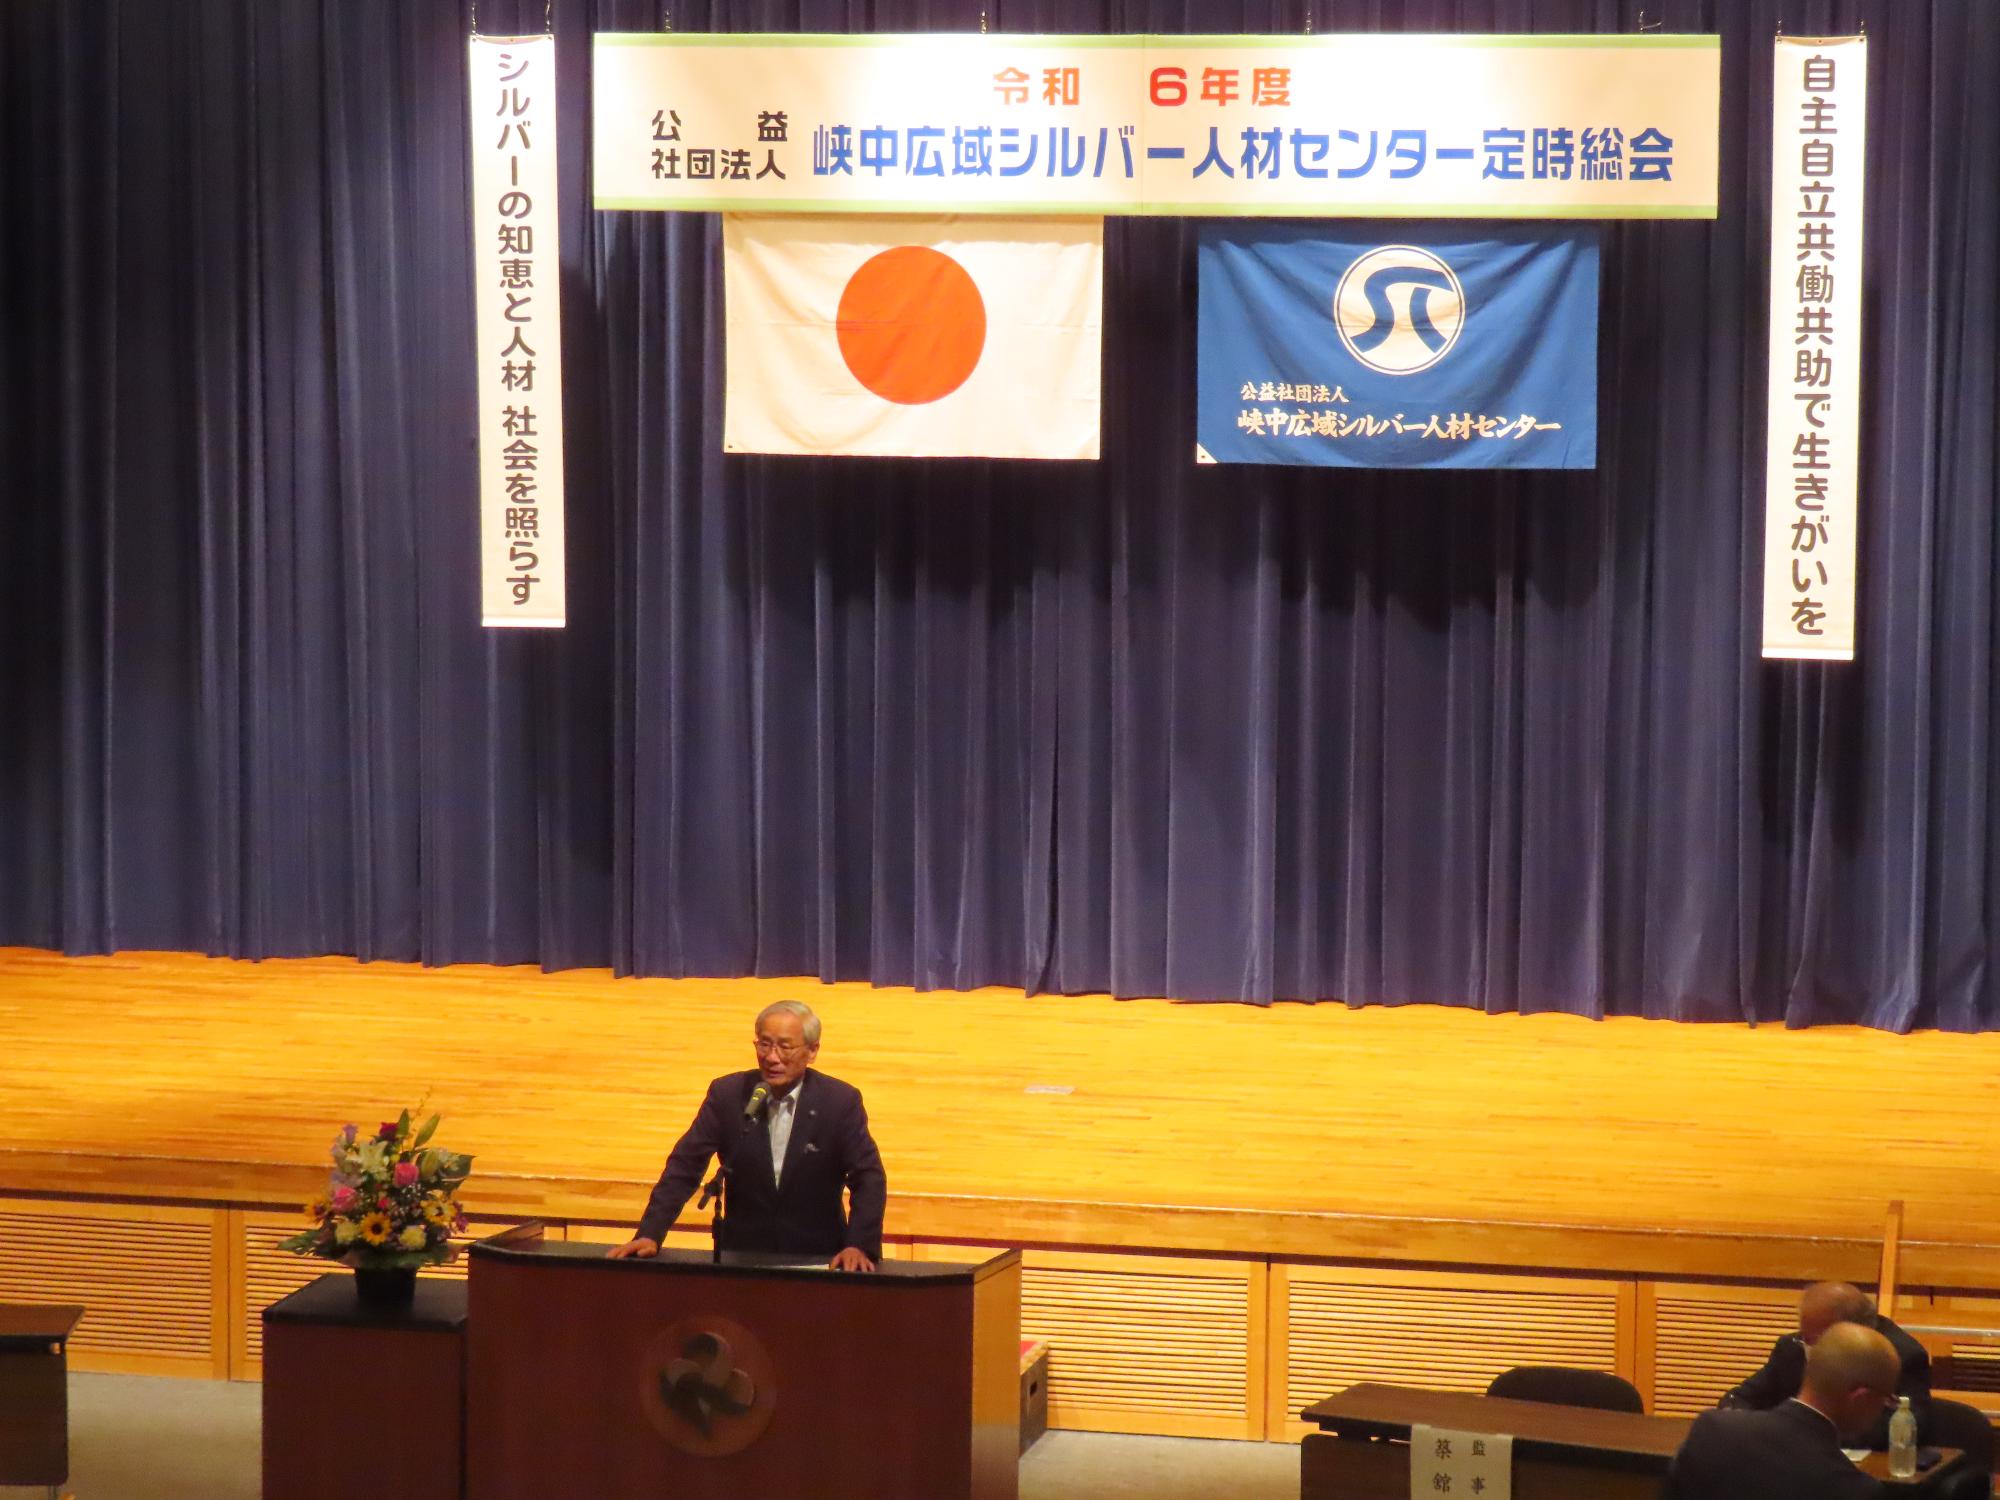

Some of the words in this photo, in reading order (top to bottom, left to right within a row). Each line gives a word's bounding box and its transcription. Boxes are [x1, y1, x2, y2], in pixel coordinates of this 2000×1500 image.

[651, 148, 787, 181] 社団法人
[813, 123, 1674, 182] 峡中広域シルバー人材センター定時総会
[1790, 54, 1838, 636] 自主自立共働共助で生きがいを
[1240, 381, 1350, 403] 公益社団法人
[1237, 407, 1562, 440] 峡中広域シルバー人材センター
